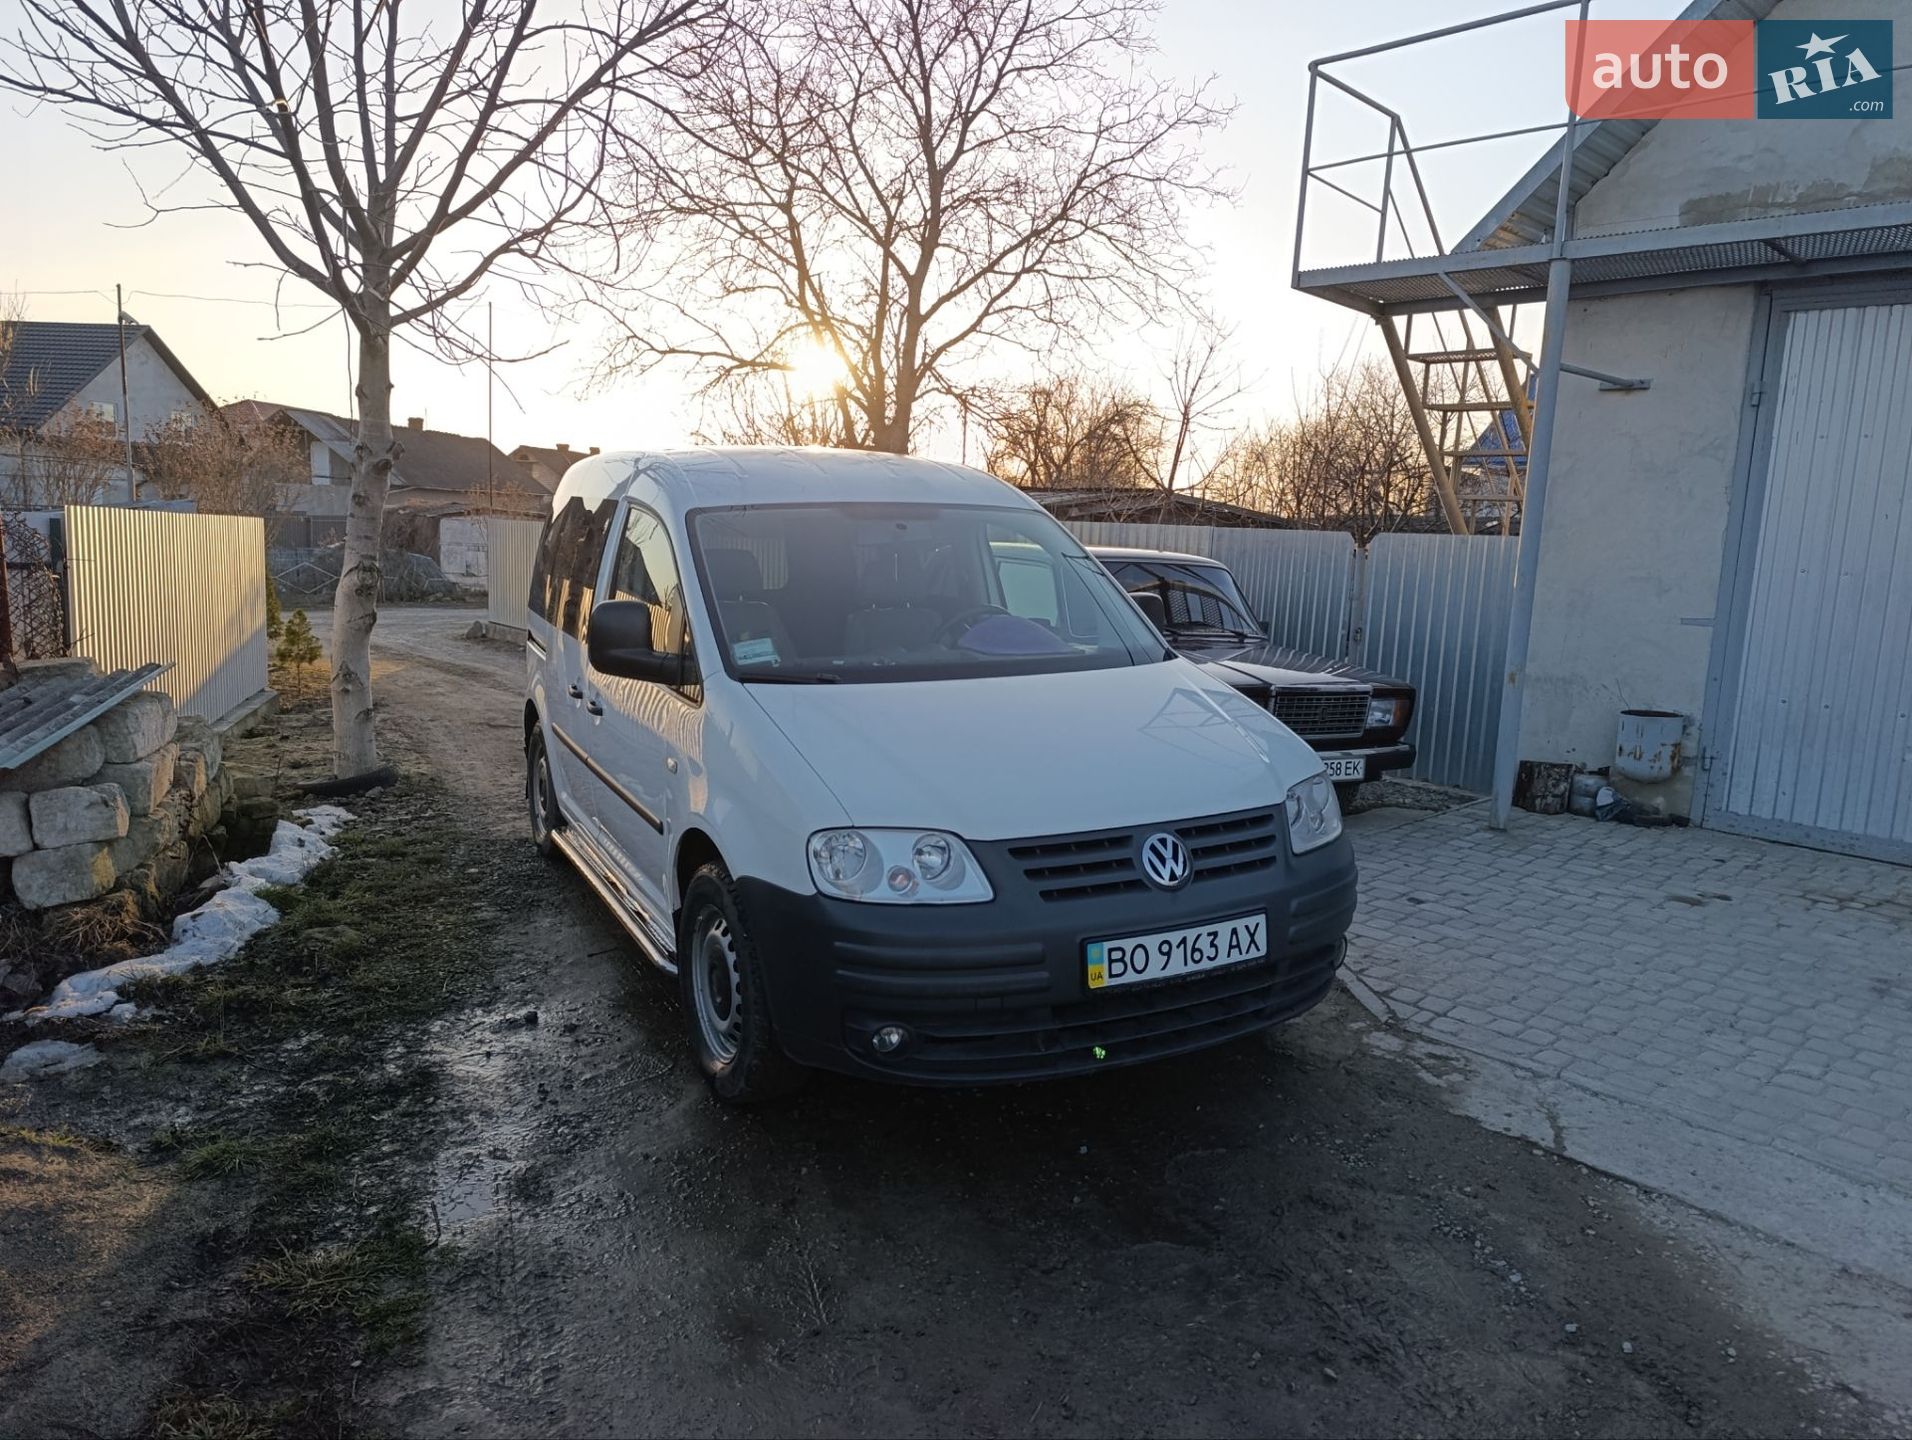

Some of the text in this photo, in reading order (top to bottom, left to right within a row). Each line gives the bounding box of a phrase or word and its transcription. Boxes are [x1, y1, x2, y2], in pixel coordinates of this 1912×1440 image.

[1344, 760, 1361, 776] EK
[1107, 944, 1149, 979] BO
[1158, 930, 1219, 972] 9163
[1226, 922, 1261, 959] AX
[1090, 971, 1104, 982] UA
